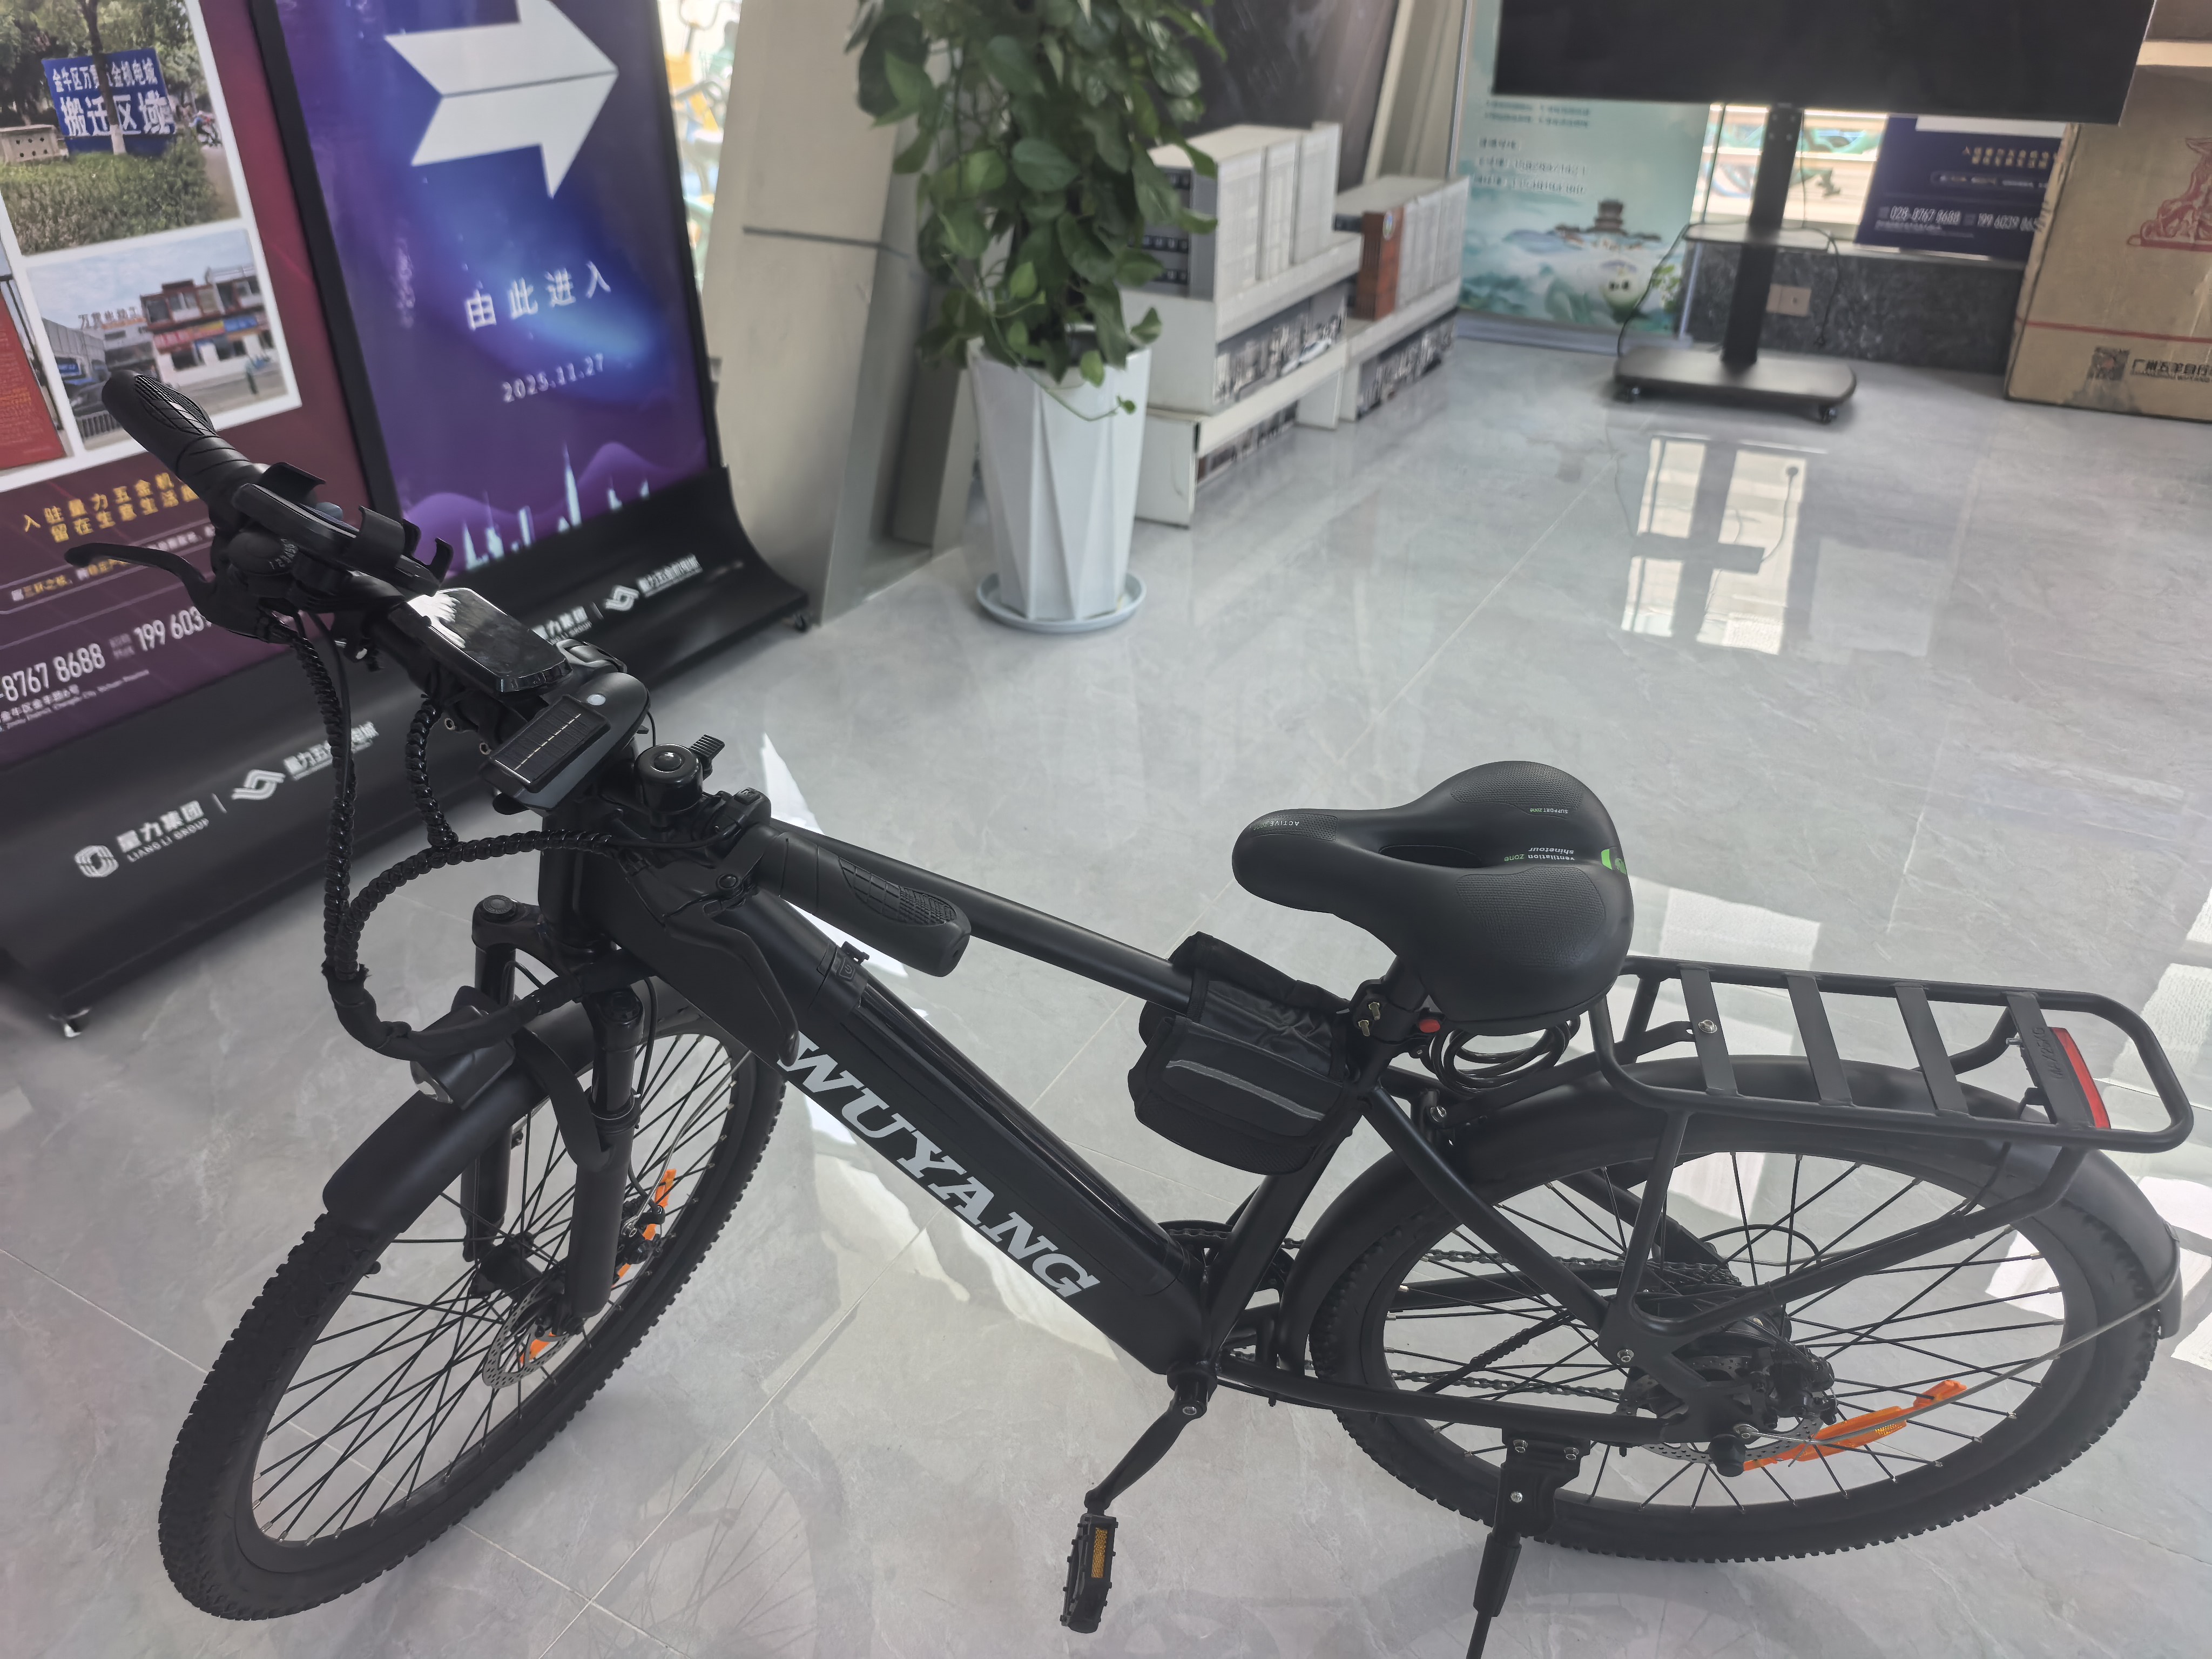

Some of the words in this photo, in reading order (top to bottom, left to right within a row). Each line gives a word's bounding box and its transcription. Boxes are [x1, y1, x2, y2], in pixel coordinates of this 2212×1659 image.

[52, 57, 158, 92] 金牛区万金机电城
[60, 90, 176, 136] 搬迁区域
[464, 260, 611, 331] 由此进入
[501, 352, 604, 403] 2025.11.27
[53, 643, 106, 683] 8688
[133, 619, 166, 652] 199
[170, 605, 212, 639] 603
[1504, 853, 1526, 862] zone
[1528, 847, 1575, 855] shinetour
[777, 1029, 1101, 1297] WUYANG
